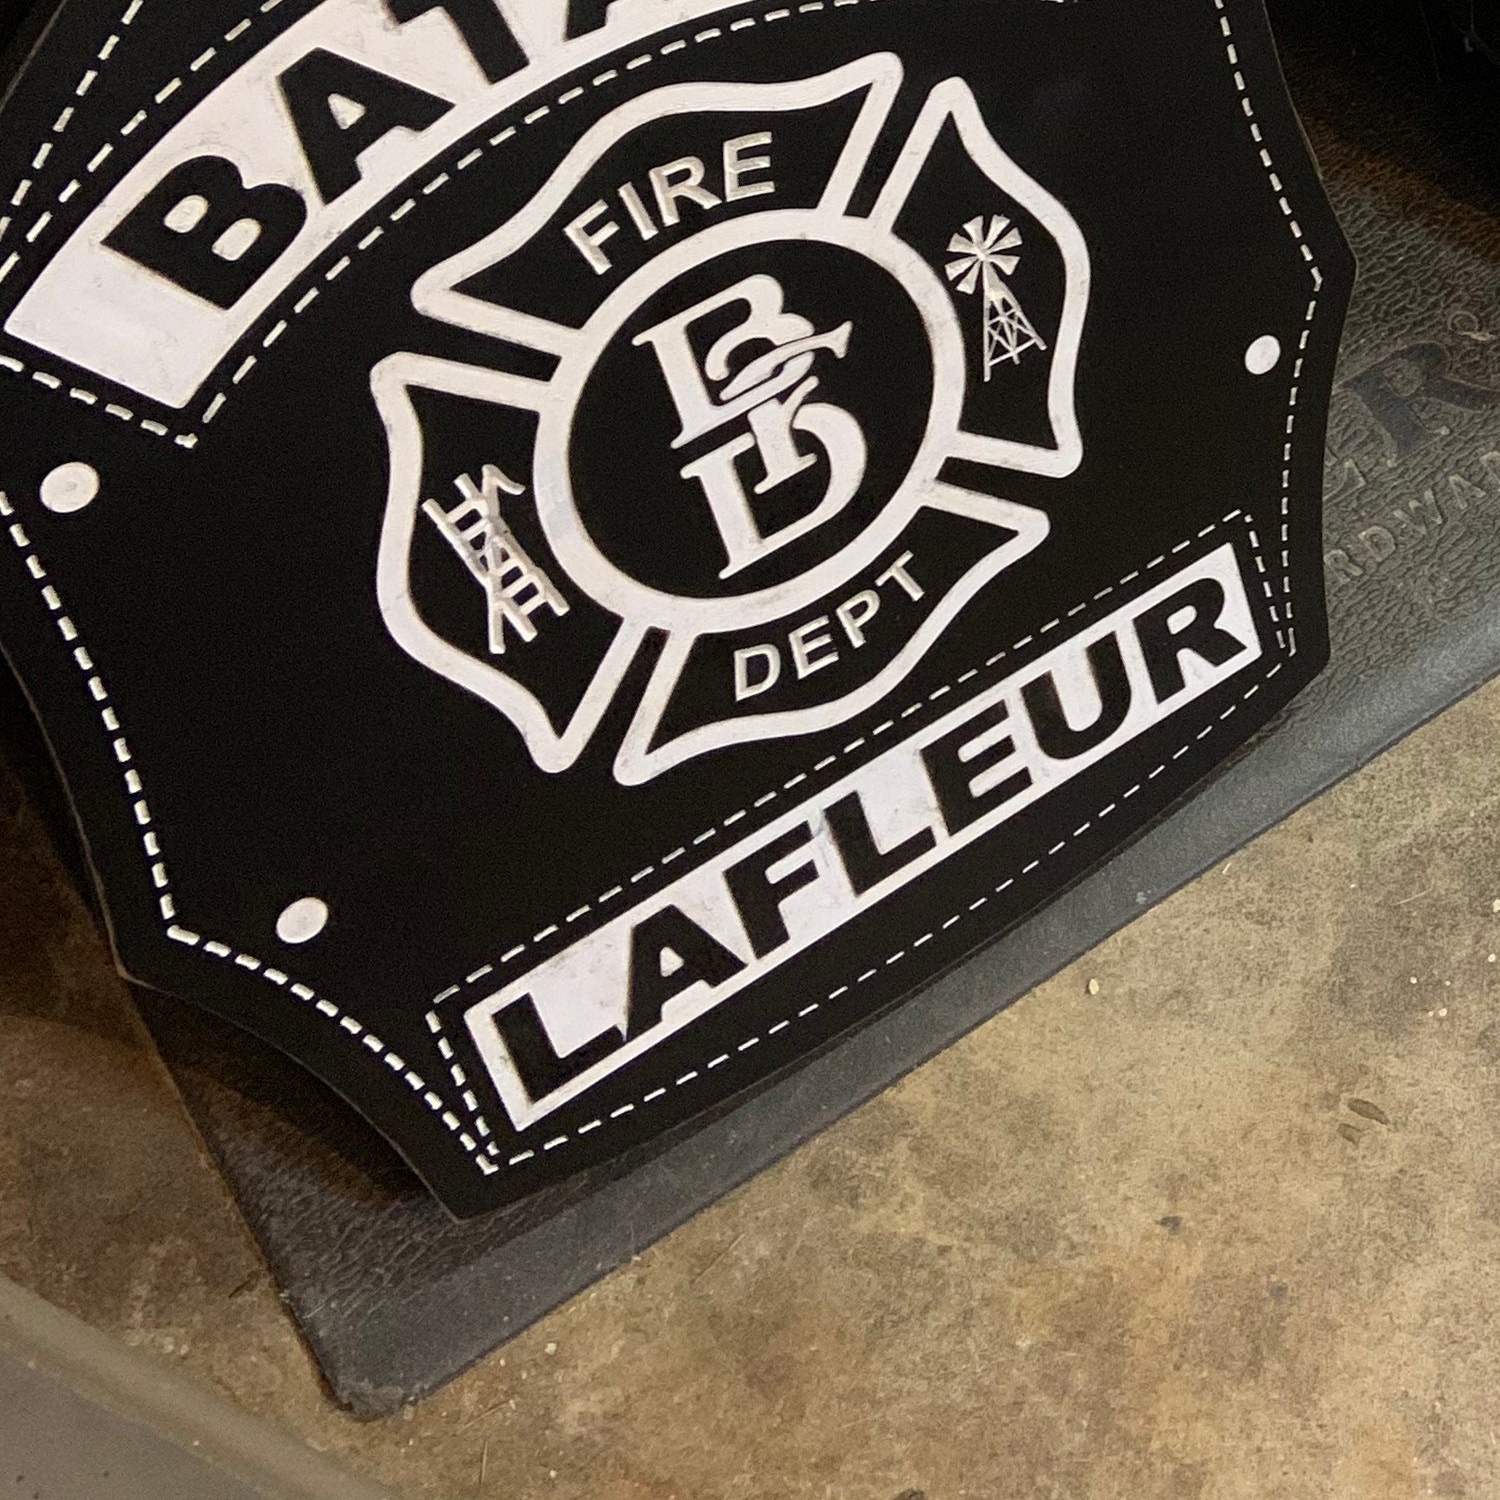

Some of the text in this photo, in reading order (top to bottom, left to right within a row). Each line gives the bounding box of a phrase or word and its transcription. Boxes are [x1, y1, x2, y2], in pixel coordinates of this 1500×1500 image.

[564, 131, 776, 275] FIRE
[732, 550, 929, 702] DEPT
[490, 576, 1249, 1105] LAFLEUR
